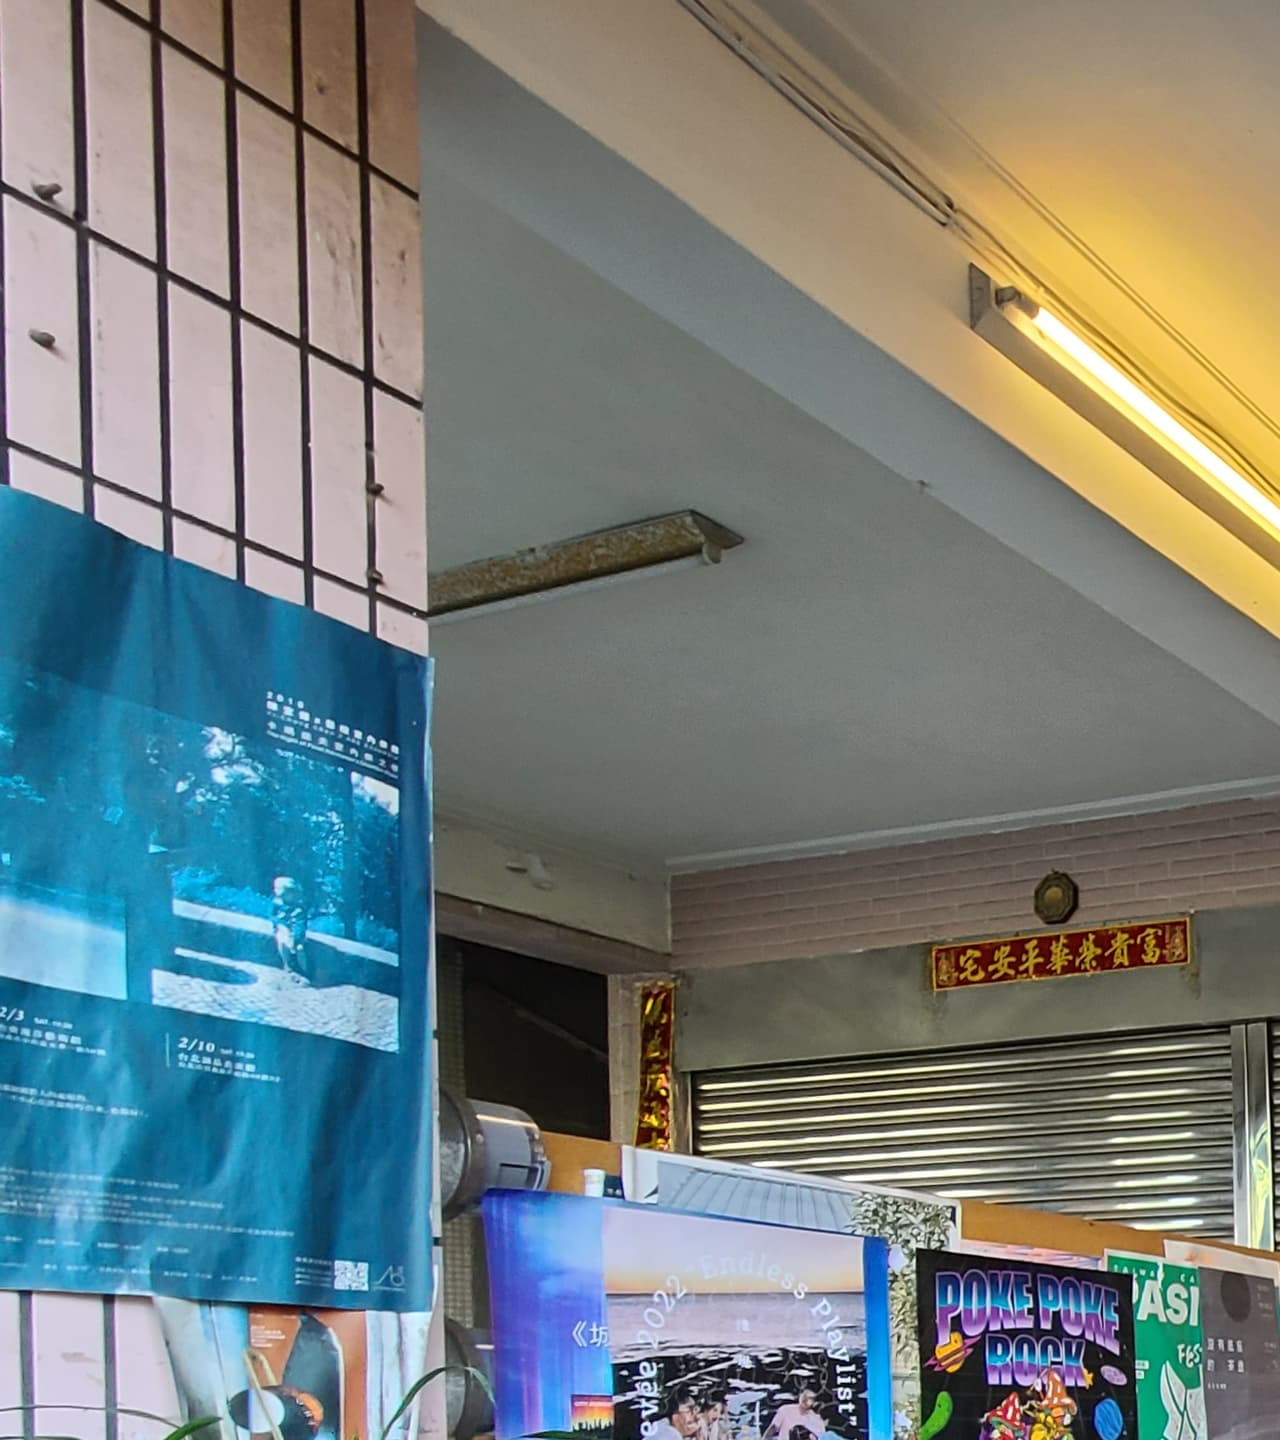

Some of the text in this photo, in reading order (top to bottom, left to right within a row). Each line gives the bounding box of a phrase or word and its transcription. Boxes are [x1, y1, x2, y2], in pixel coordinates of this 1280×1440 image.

[958, 928, 1163, 982] 富貴榮華平安宅
[935, 1268, 1035, 1347] POKE
[1036, 1273, 1121, 1356] POKE
[1132, 1278, 1200, 1328] ASI
[984, 1332, 1089, 1388] ROCK
